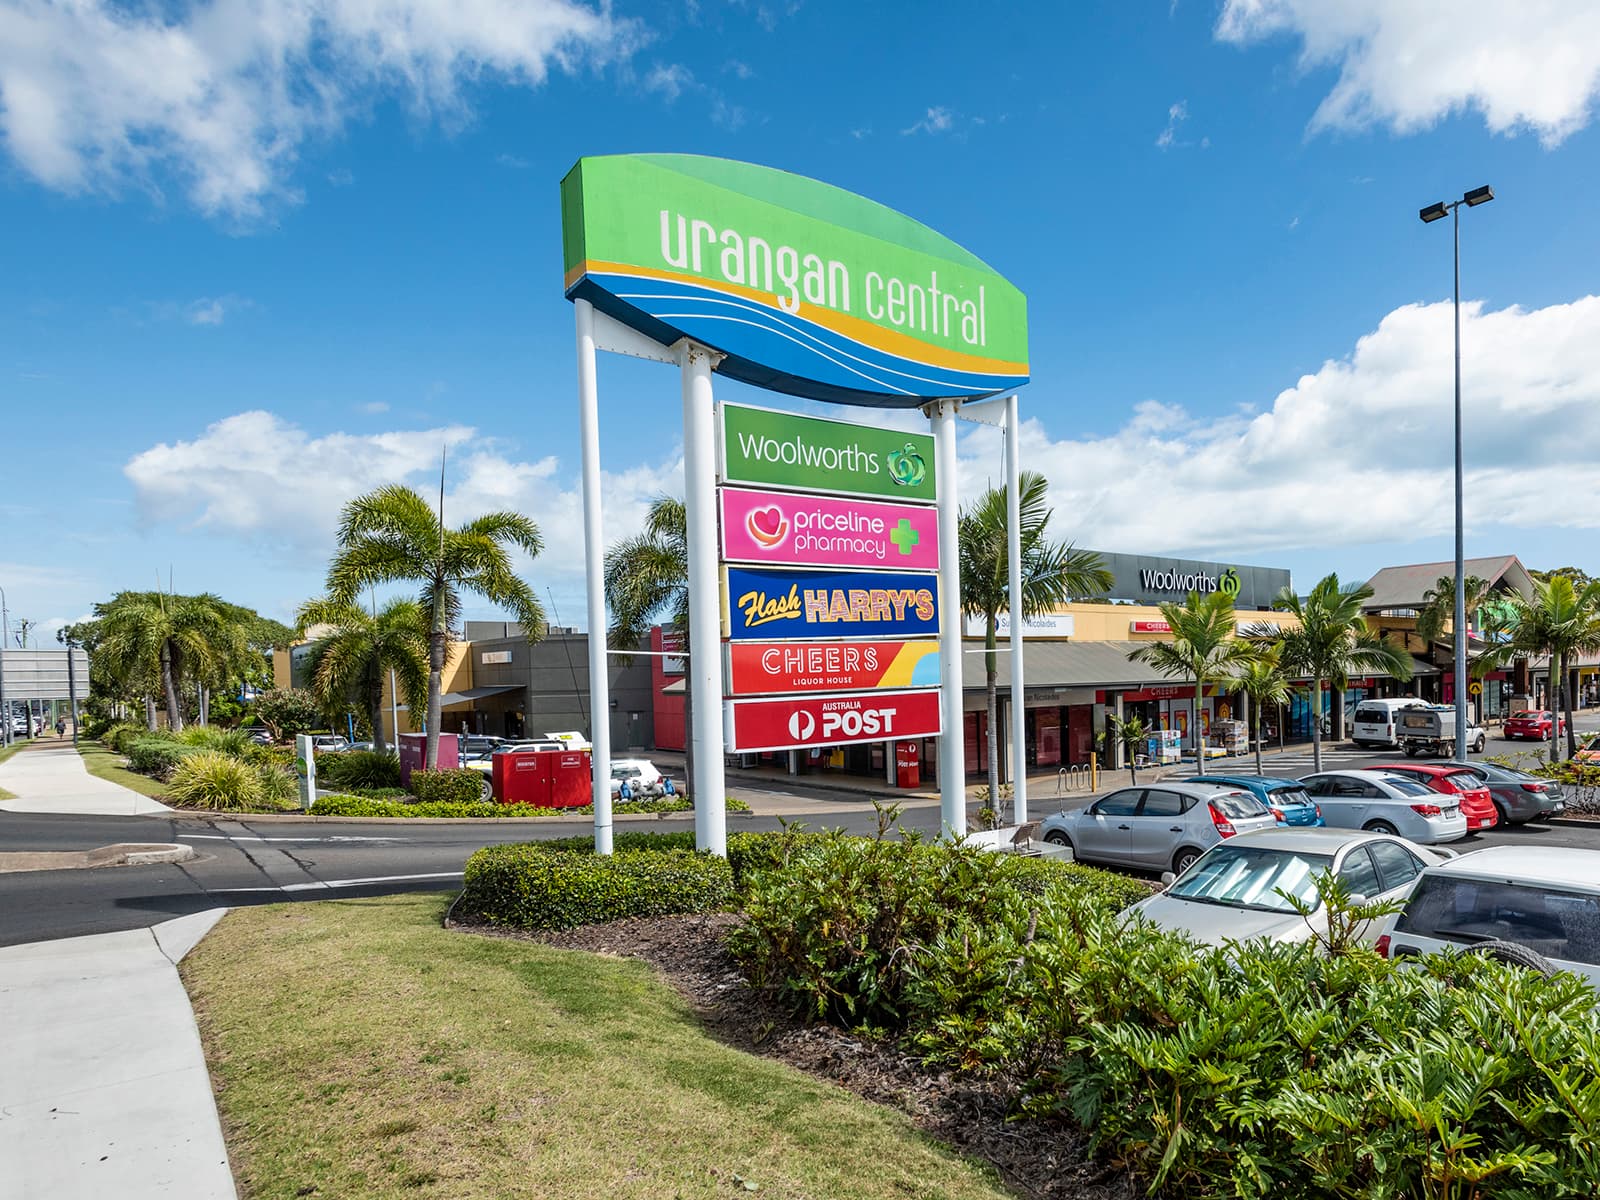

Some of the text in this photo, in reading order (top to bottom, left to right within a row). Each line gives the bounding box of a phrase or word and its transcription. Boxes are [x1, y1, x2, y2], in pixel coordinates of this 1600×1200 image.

[660, 209, 986, 347] urangan central
[738, 432, 880, 474] Woolworths
[794, 509, 885, 533] priceline
[794, 531, 886, 559] pharmacy
[1142, 567, 1217, 593] Woolworths
[738, 583, 935, 627] Flash HARRY'S
[761, 647, 879, 675] CHEERS
[793, 676, 853, 686] LIQUOR HOUSE
[822, 701, 862, 711] AUSTRALIA
[822, 708, 897, 738] POST
